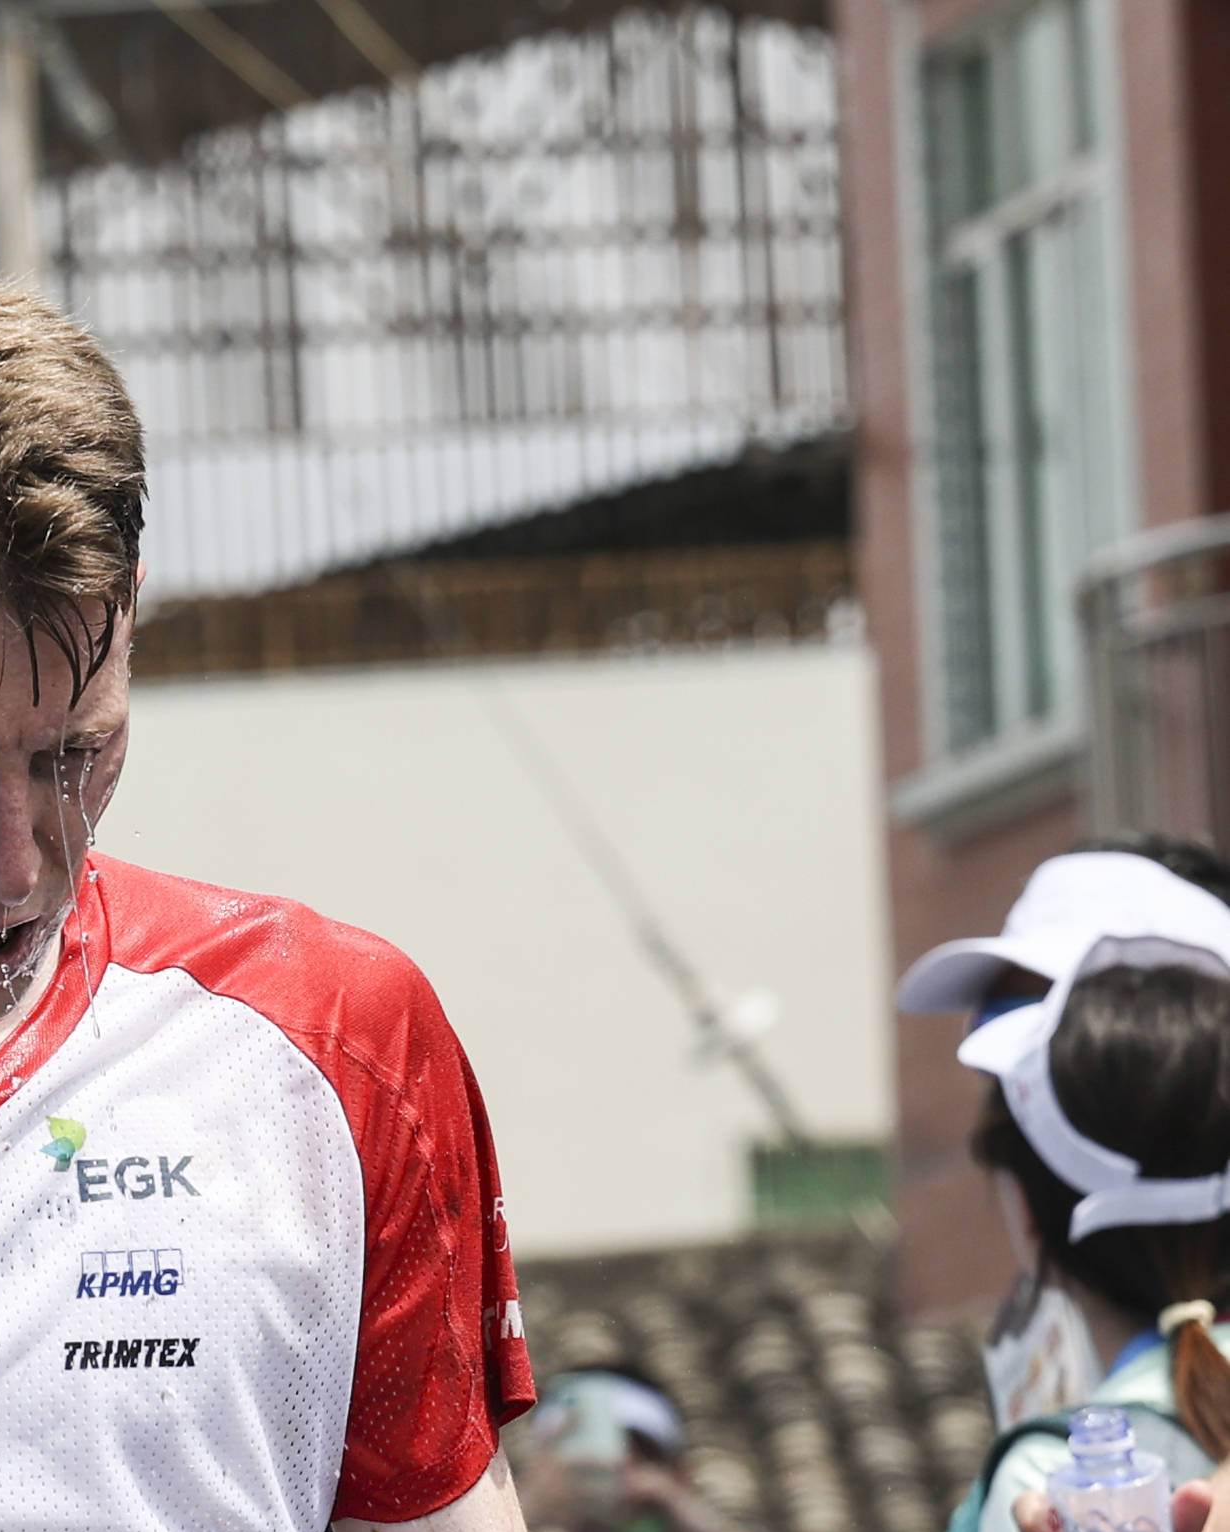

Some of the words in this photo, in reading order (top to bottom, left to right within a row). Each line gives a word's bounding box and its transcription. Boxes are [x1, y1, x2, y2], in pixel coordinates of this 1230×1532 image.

[76, 1155, 202, 1203] EGK
[76, 1268, 179, 1299] KPMG
[64, 1337, 201, 1370] TRIMTEX
